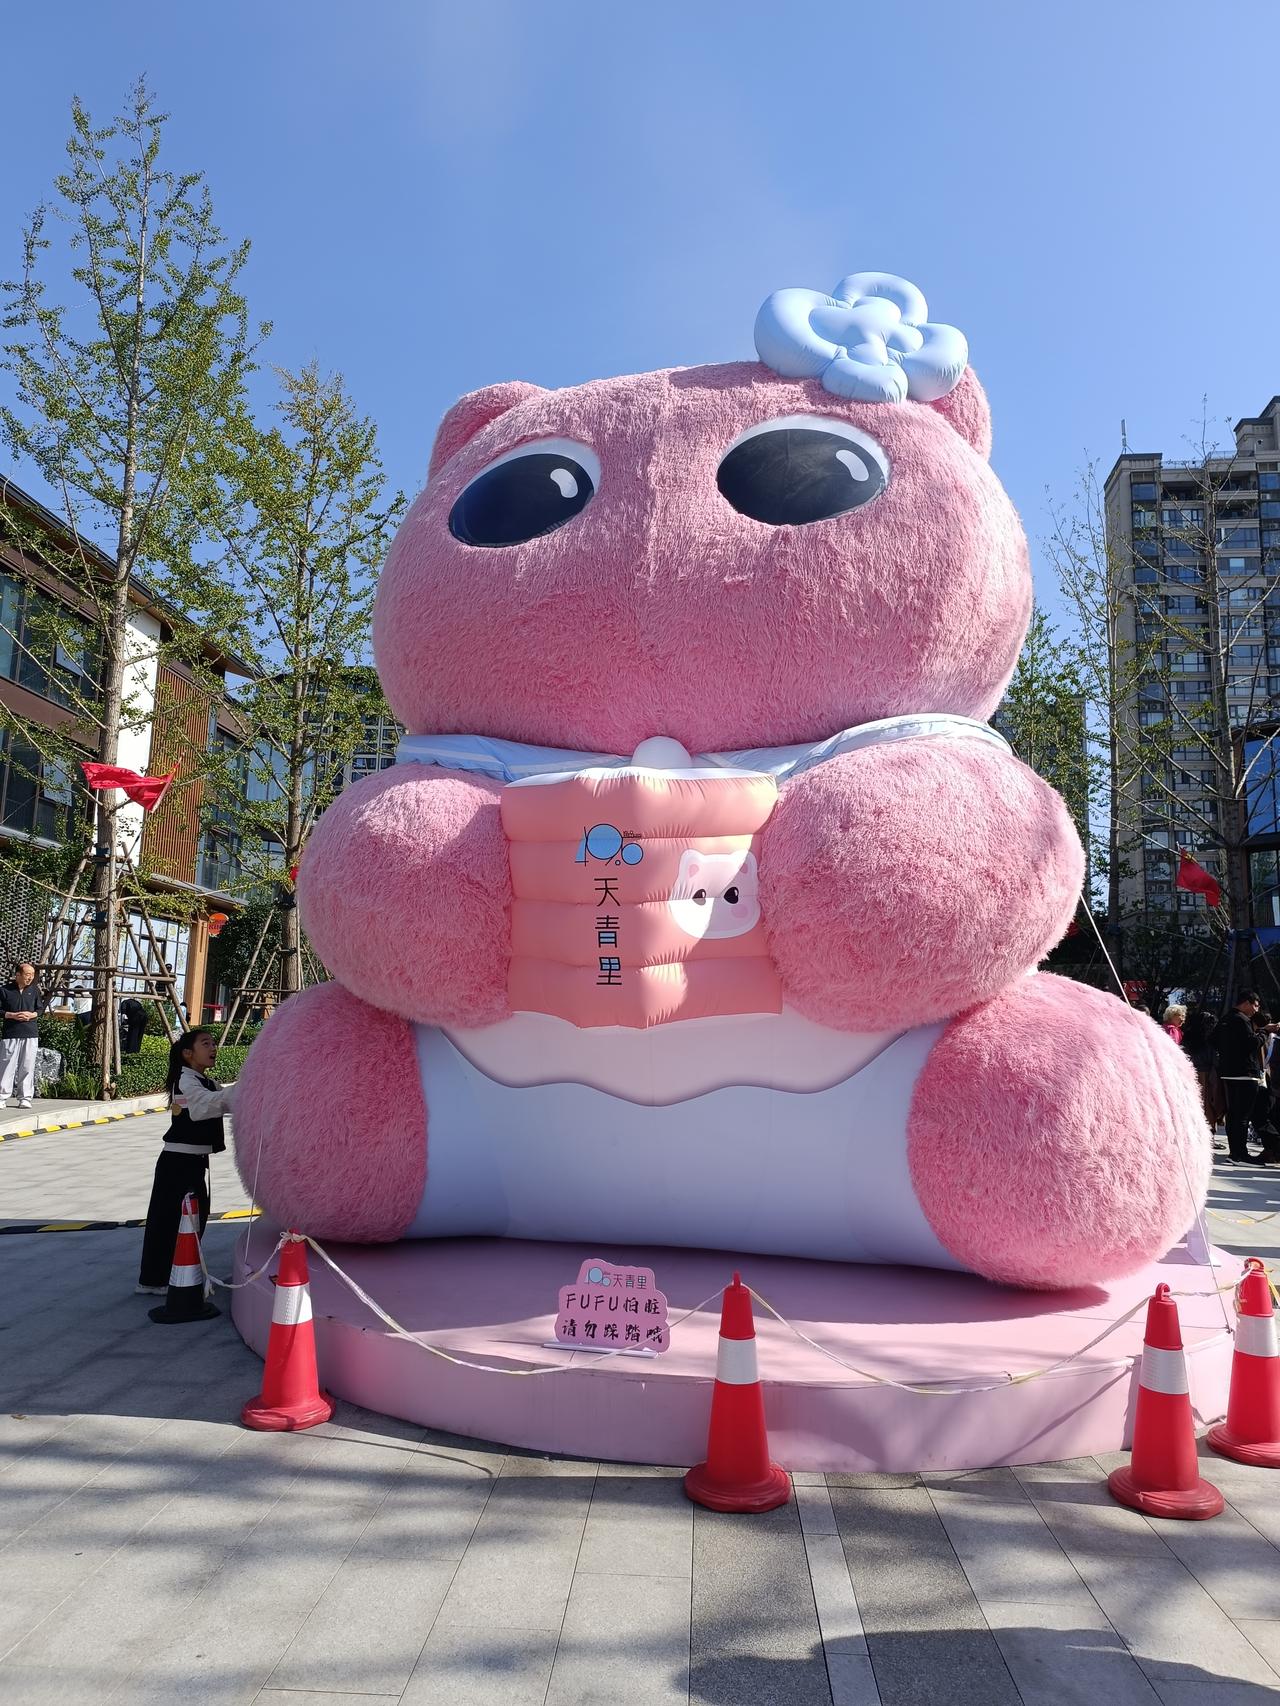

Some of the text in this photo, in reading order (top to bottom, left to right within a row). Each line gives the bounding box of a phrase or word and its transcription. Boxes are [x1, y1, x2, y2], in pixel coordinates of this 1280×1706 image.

[594, 877, 622, 985] 天青里
[613, 1273, 647, 1290] 天青里
